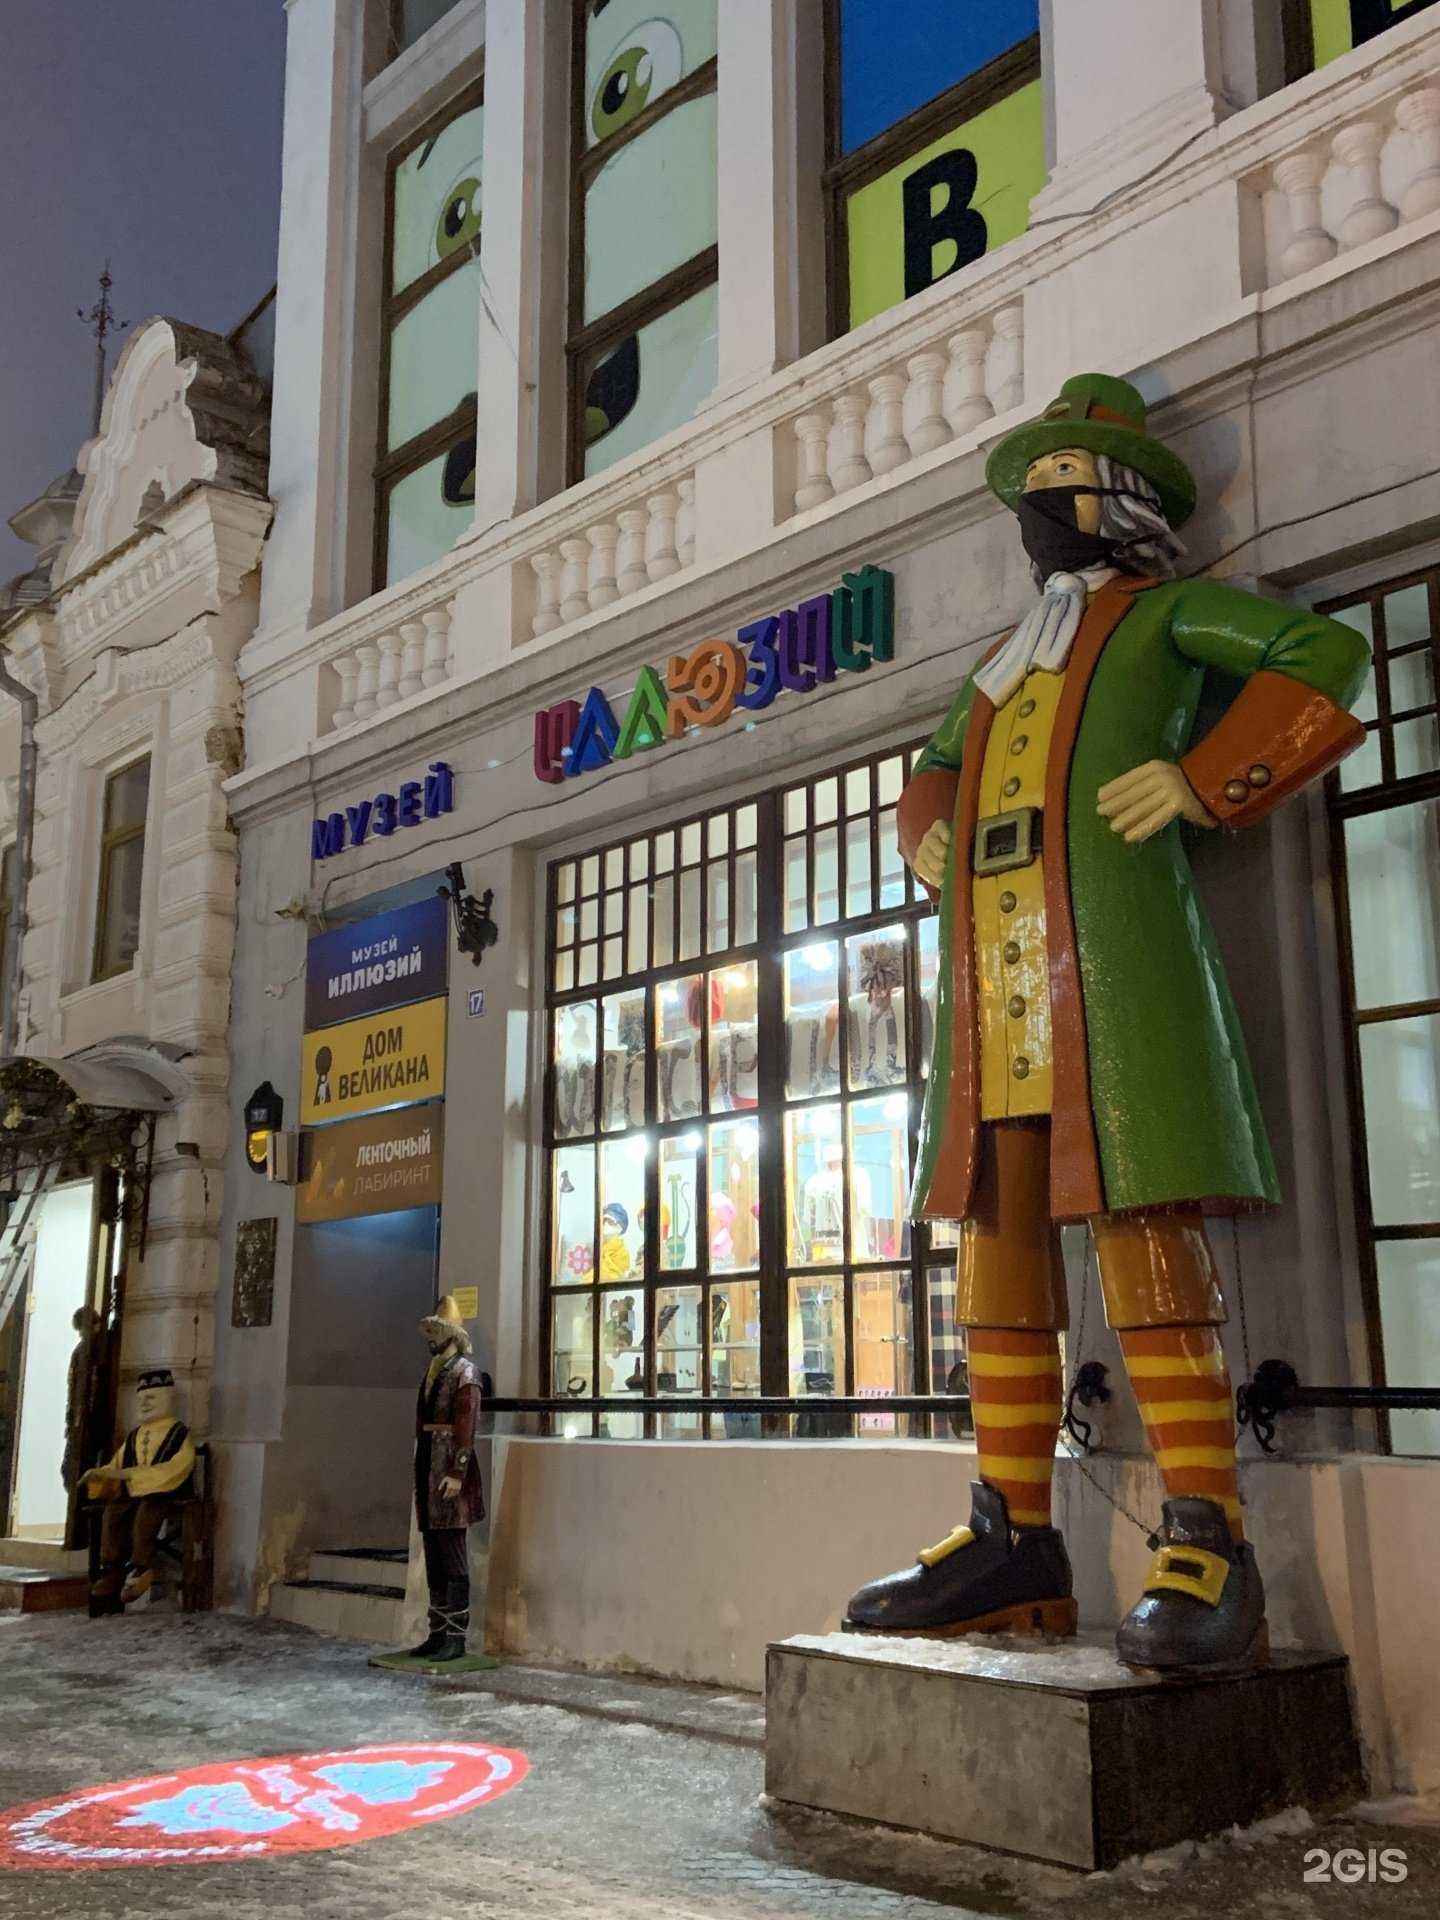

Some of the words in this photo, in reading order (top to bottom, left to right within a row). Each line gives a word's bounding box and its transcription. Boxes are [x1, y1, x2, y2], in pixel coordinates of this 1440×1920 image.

[312, 762, 455, 860] МУЗЕЙ
[534, 564, 895, 784] ИЛЛЮЗИЙ
[351, 934, 398, 964] МУЗЕЙ
[328, 945, 422, 999] ИЛЛЮЗИЙ
[470, 991, 483, 1014] 17
[362, 1026, 403, 1065] ДОМ
[338, 1054, 429, 1100] ВЕЛИКАНА
[356, 1128, 431, 1168] ЛЕНТОЧНЫЙ
[353, 1164, 432, 1196] ЛАБИРИНТ
